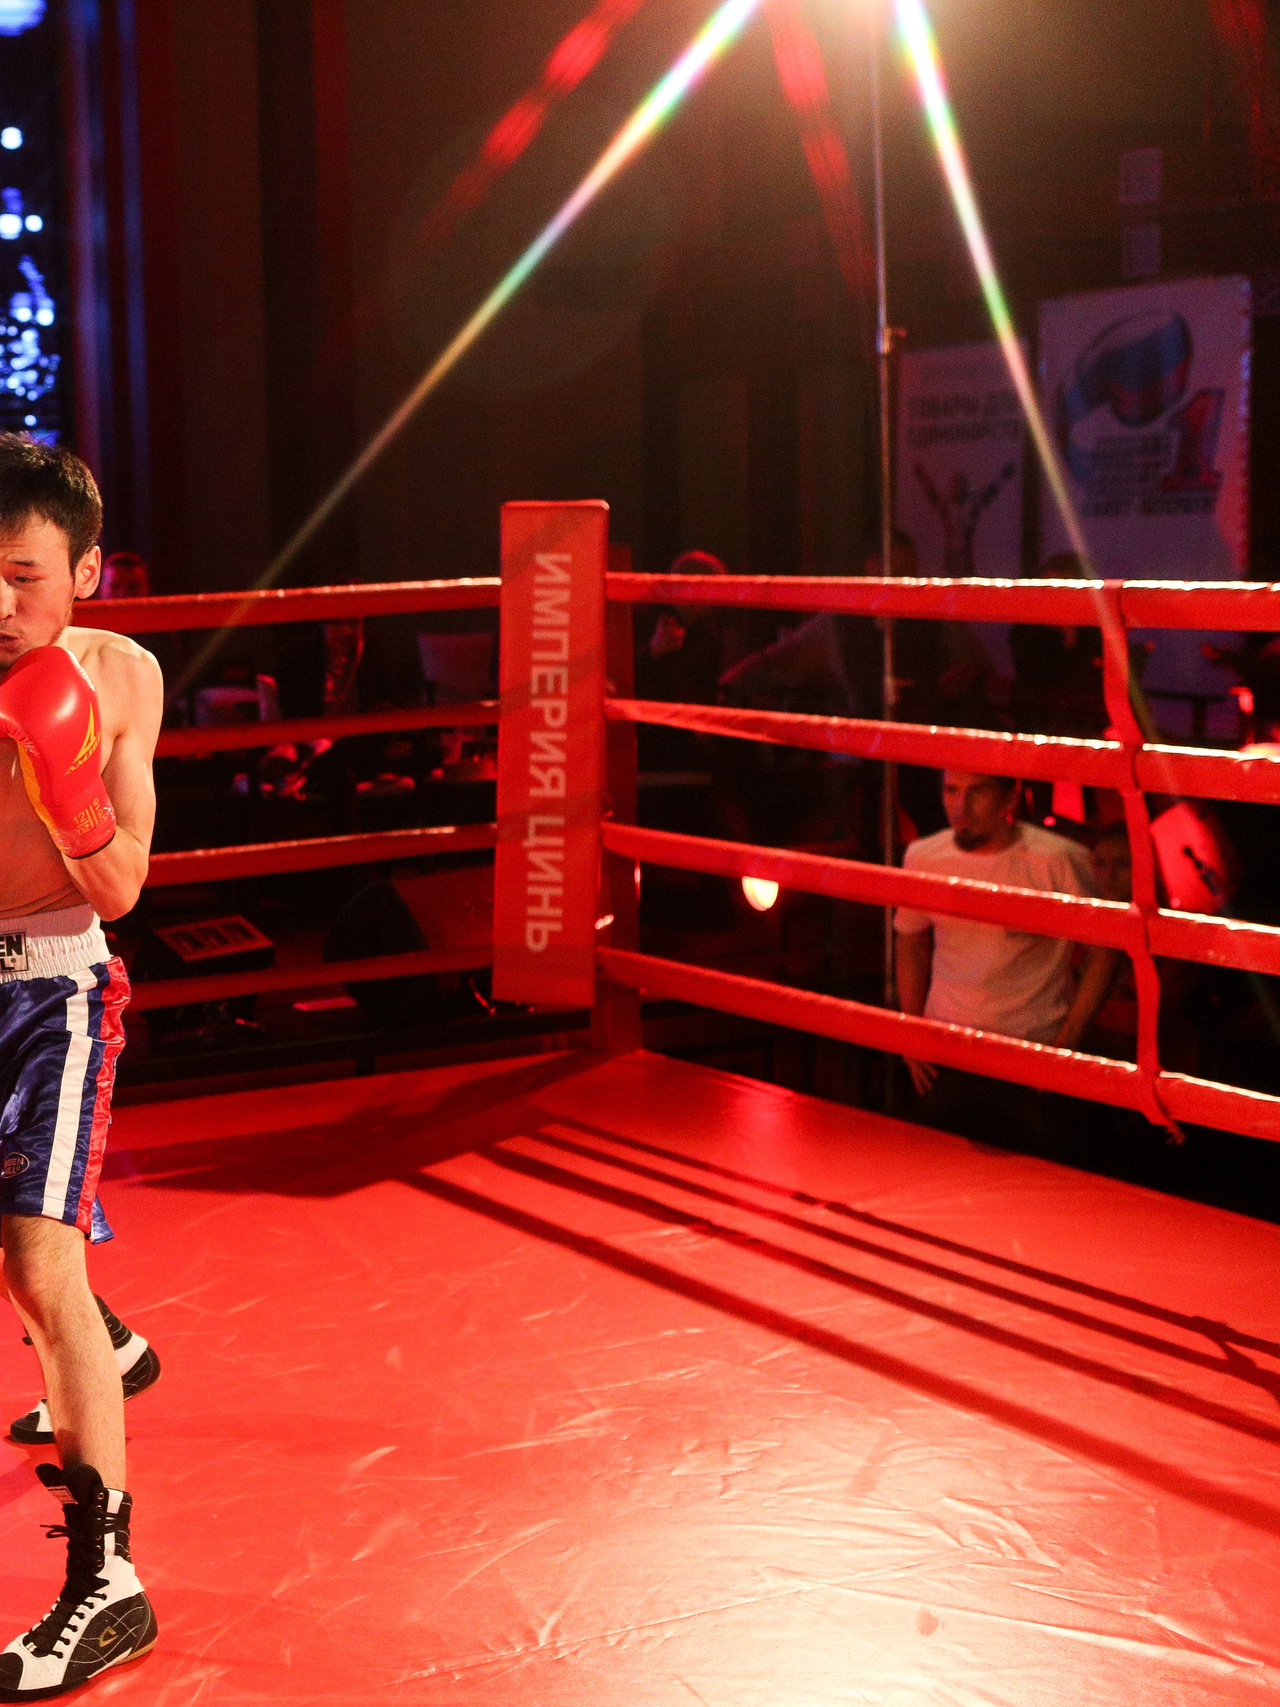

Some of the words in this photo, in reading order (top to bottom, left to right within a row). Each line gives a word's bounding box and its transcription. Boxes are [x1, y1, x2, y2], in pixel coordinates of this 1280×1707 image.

[529, 551, 573, 799] ИМПЕРИЯ
[72, 811, 87, 826] 12
[523, 816, 566, 953] ЦИНЬ
